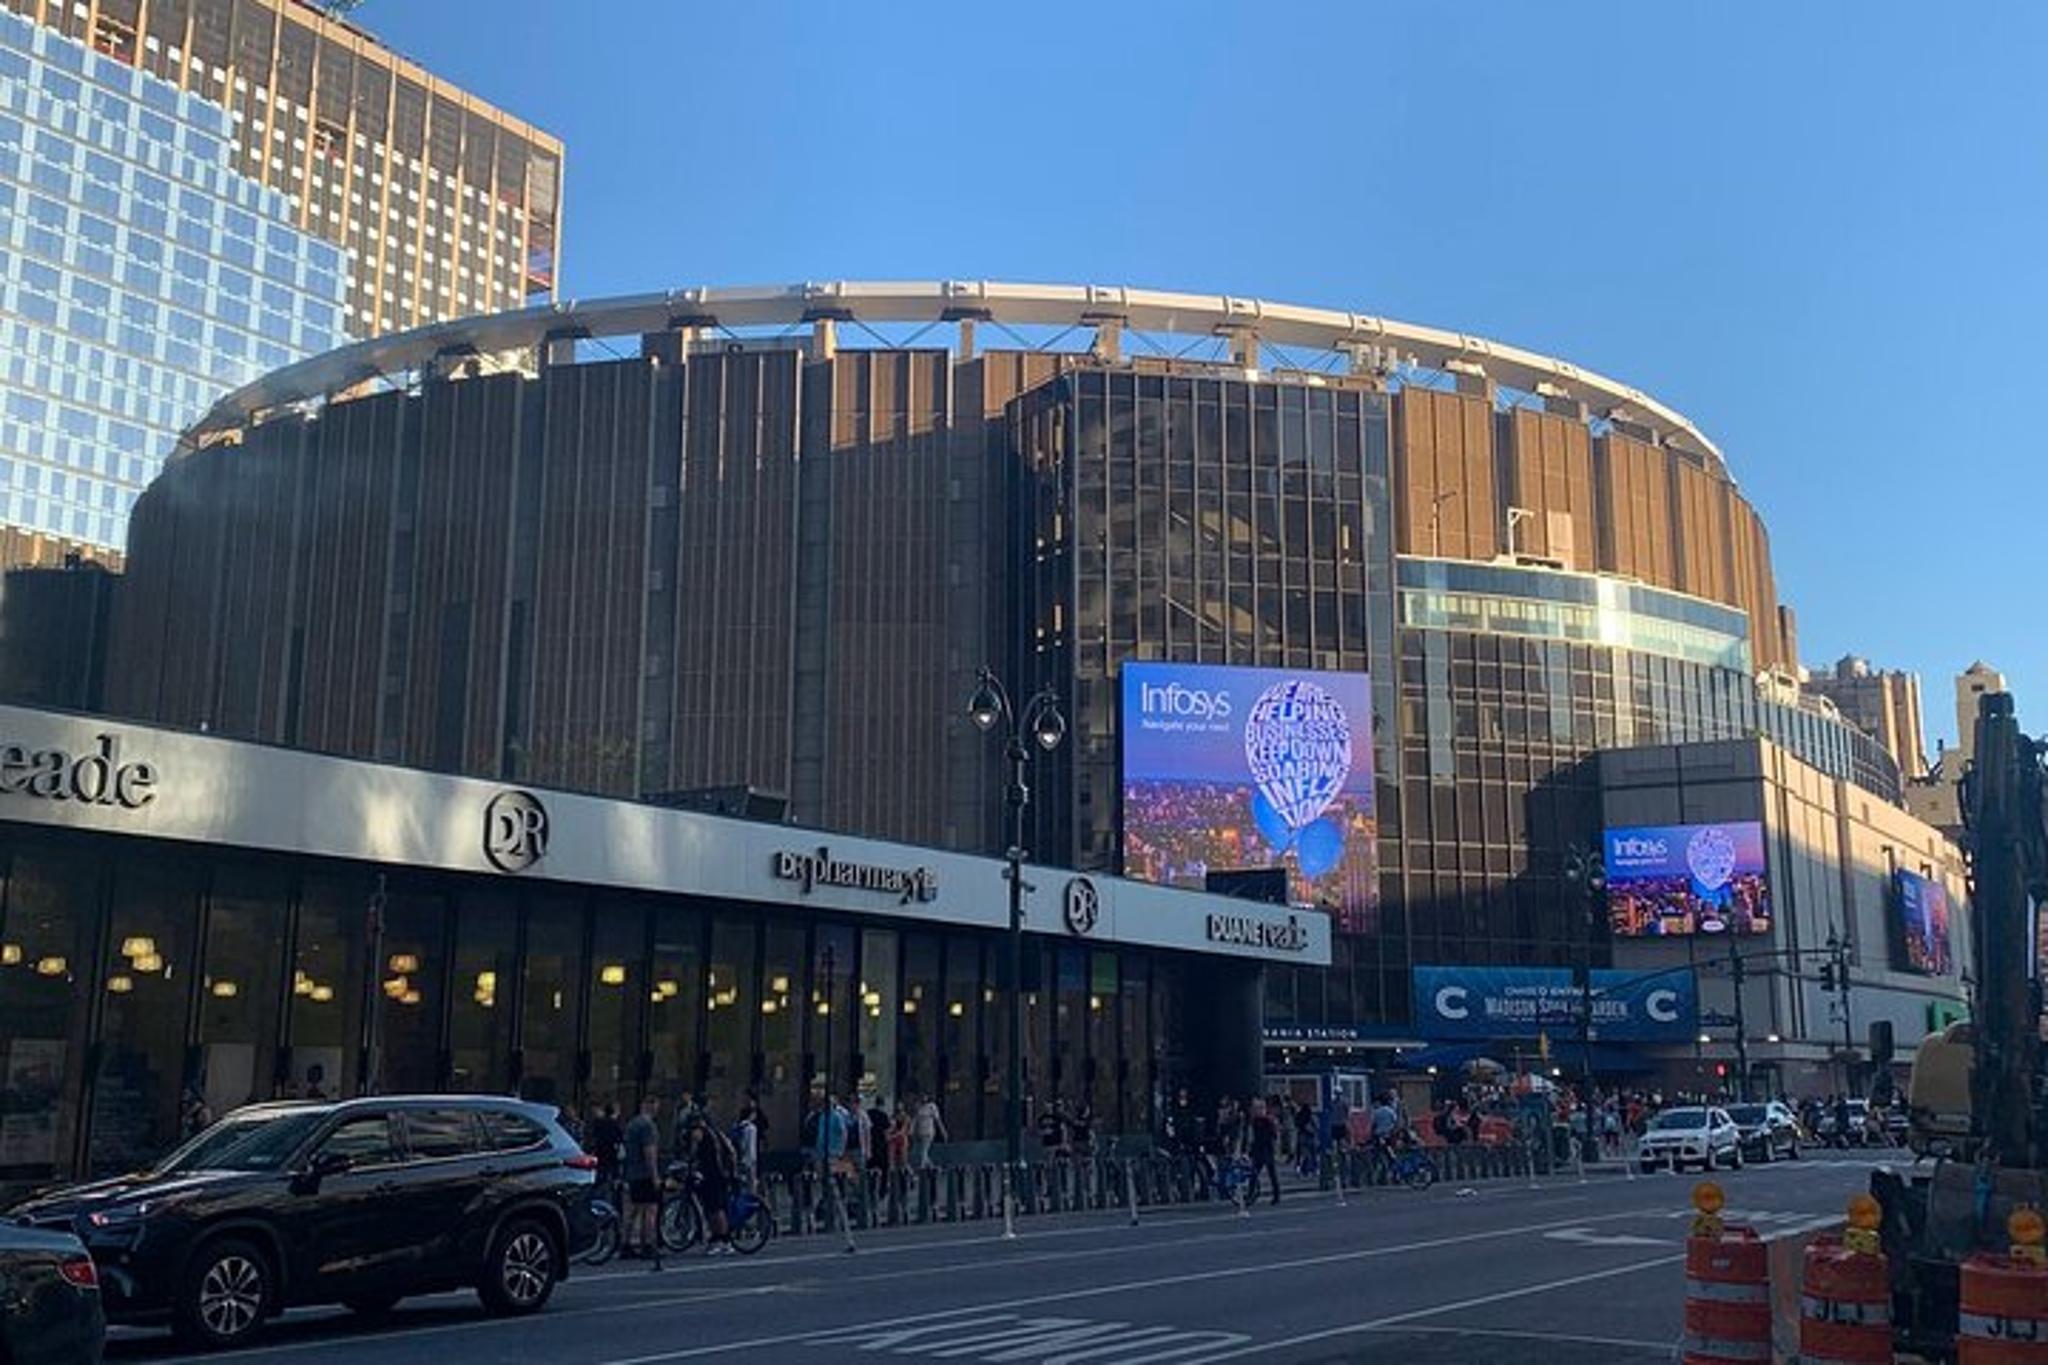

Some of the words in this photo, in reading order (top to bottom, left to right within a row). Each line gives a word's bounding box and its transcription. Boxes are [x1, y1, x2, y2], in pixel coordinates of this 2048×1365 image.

[1142, 682, 1232, 720] Infosys
[1251, 700, 1347, 722] HELPING
[1246, 719, 1350, 743] BUSINESSES
[0, 733, 159, 809] eade
[489, 800, 547, 863] DR
[1068, 884, 1098, 928] DR
[1206, 913, 1262, 948] DUANE
[1435, 986, 1469, 1020] C
[1646, 989, 1679, 1022] C
